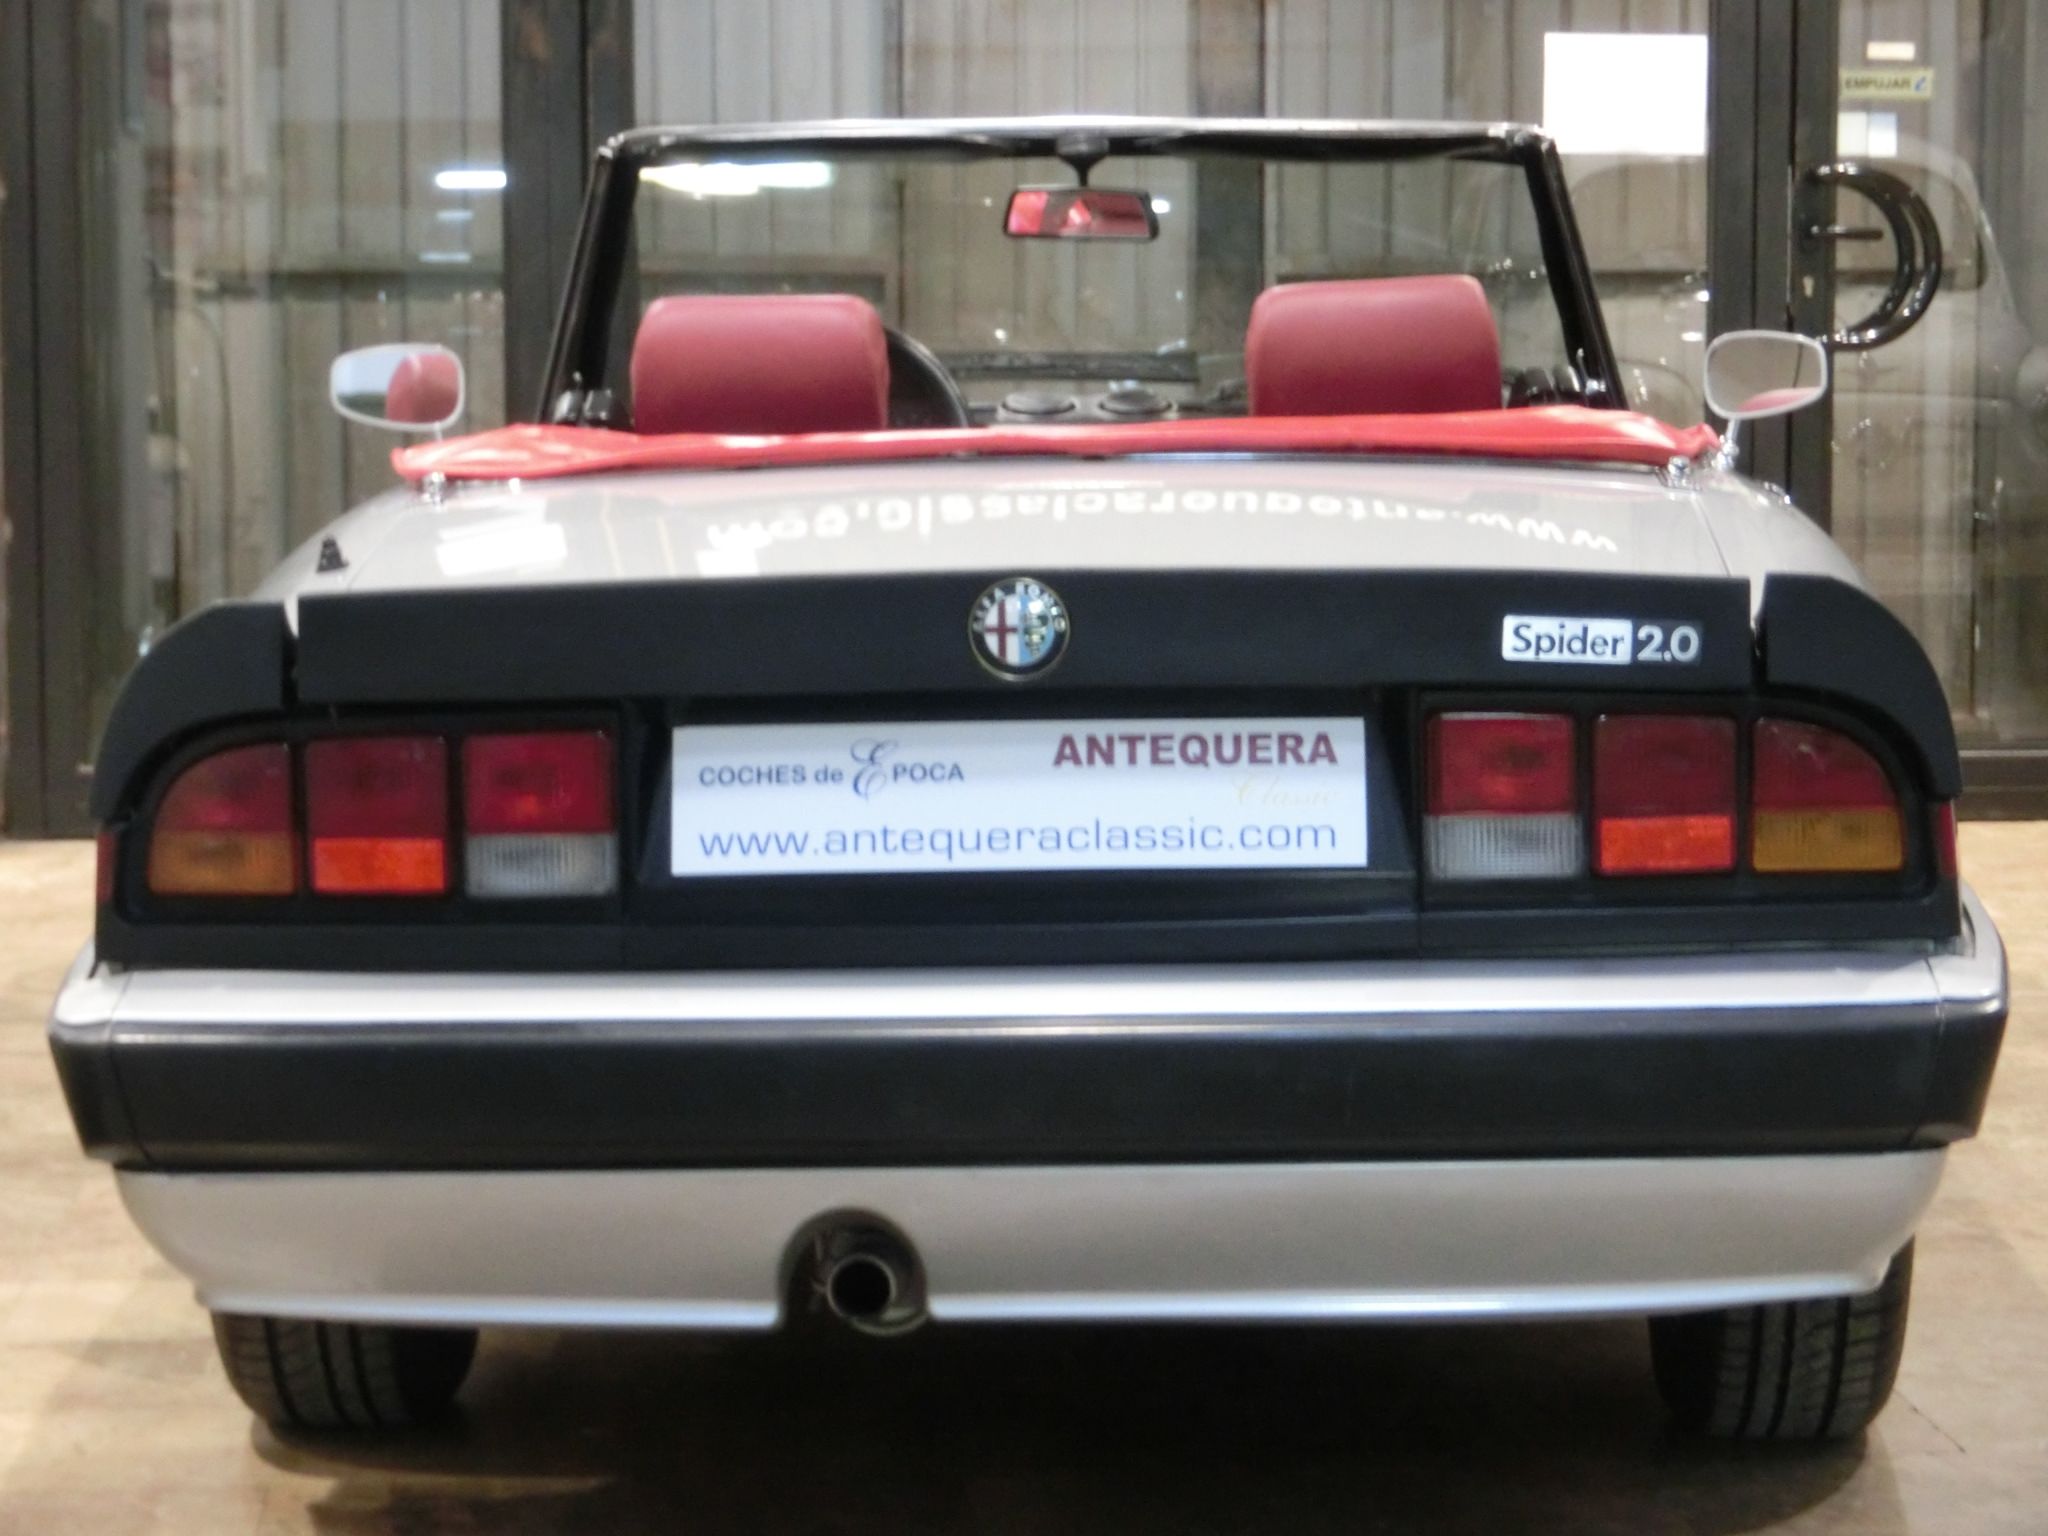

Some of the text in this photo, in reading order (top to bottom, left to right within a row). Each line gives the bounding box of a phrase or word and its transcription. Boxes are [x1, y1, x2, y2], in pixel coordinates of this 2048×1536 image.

[1844, 76, 1912, 90] EMPUJAR
[1511, 621, 1700, 663] Spider 2.0
[1052, 730, 1339, 768] ANTEQUERA
[698, 764, 807, 788] COCHES
[813, 763, 845, 785] de
[698, 816, 1337, 862] www.antequeraclassic.com
